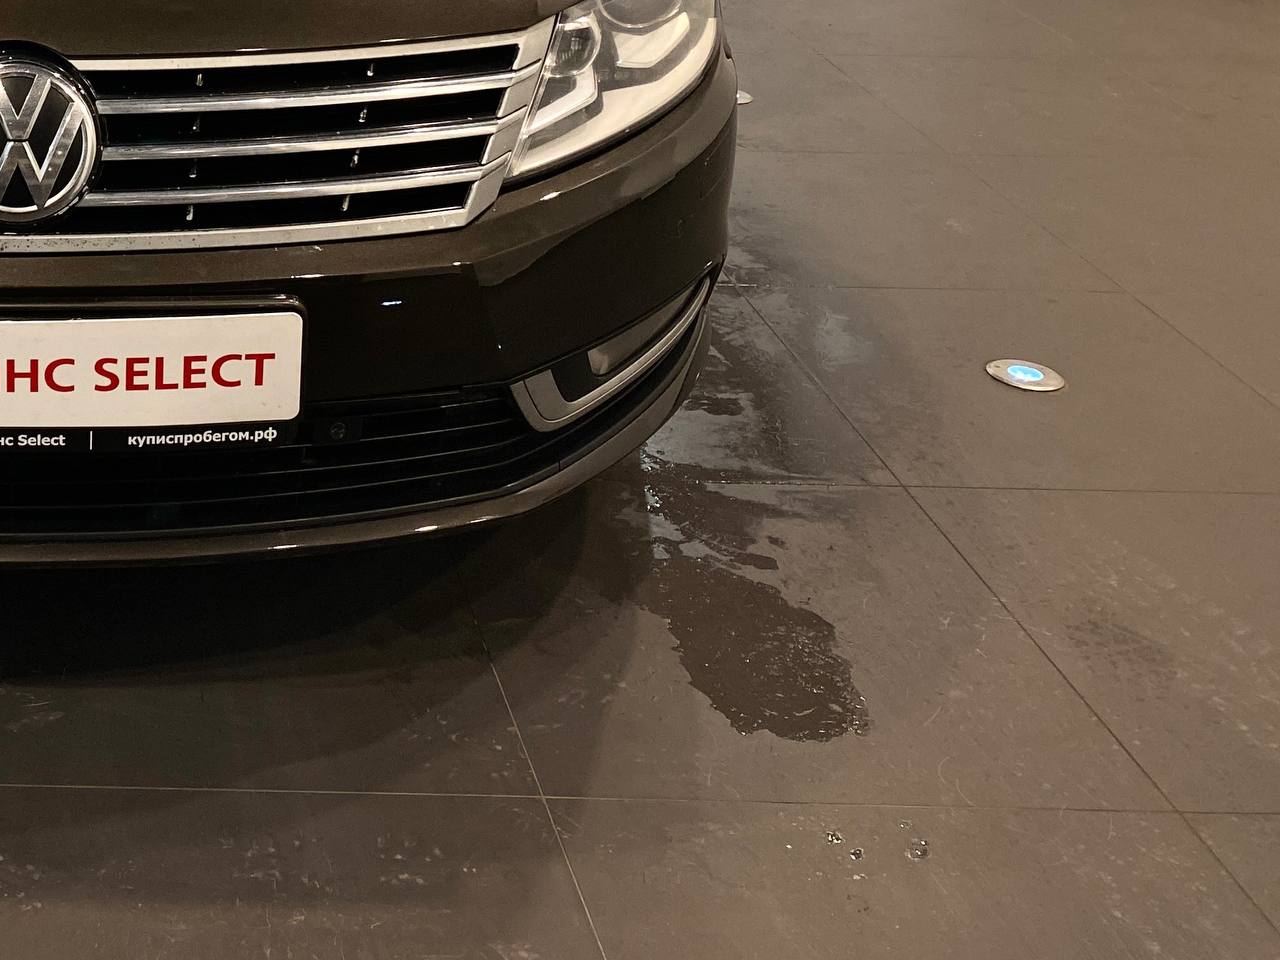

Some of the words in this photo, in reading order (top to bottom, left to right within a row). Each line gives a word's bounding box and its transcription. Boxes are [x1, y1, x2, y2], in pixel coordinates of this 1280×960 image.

[93, 352, 276, 392] SELECT
[17, 433, 66, 447] Select
[127, 426, 278, 448] куписпробегом.рф
